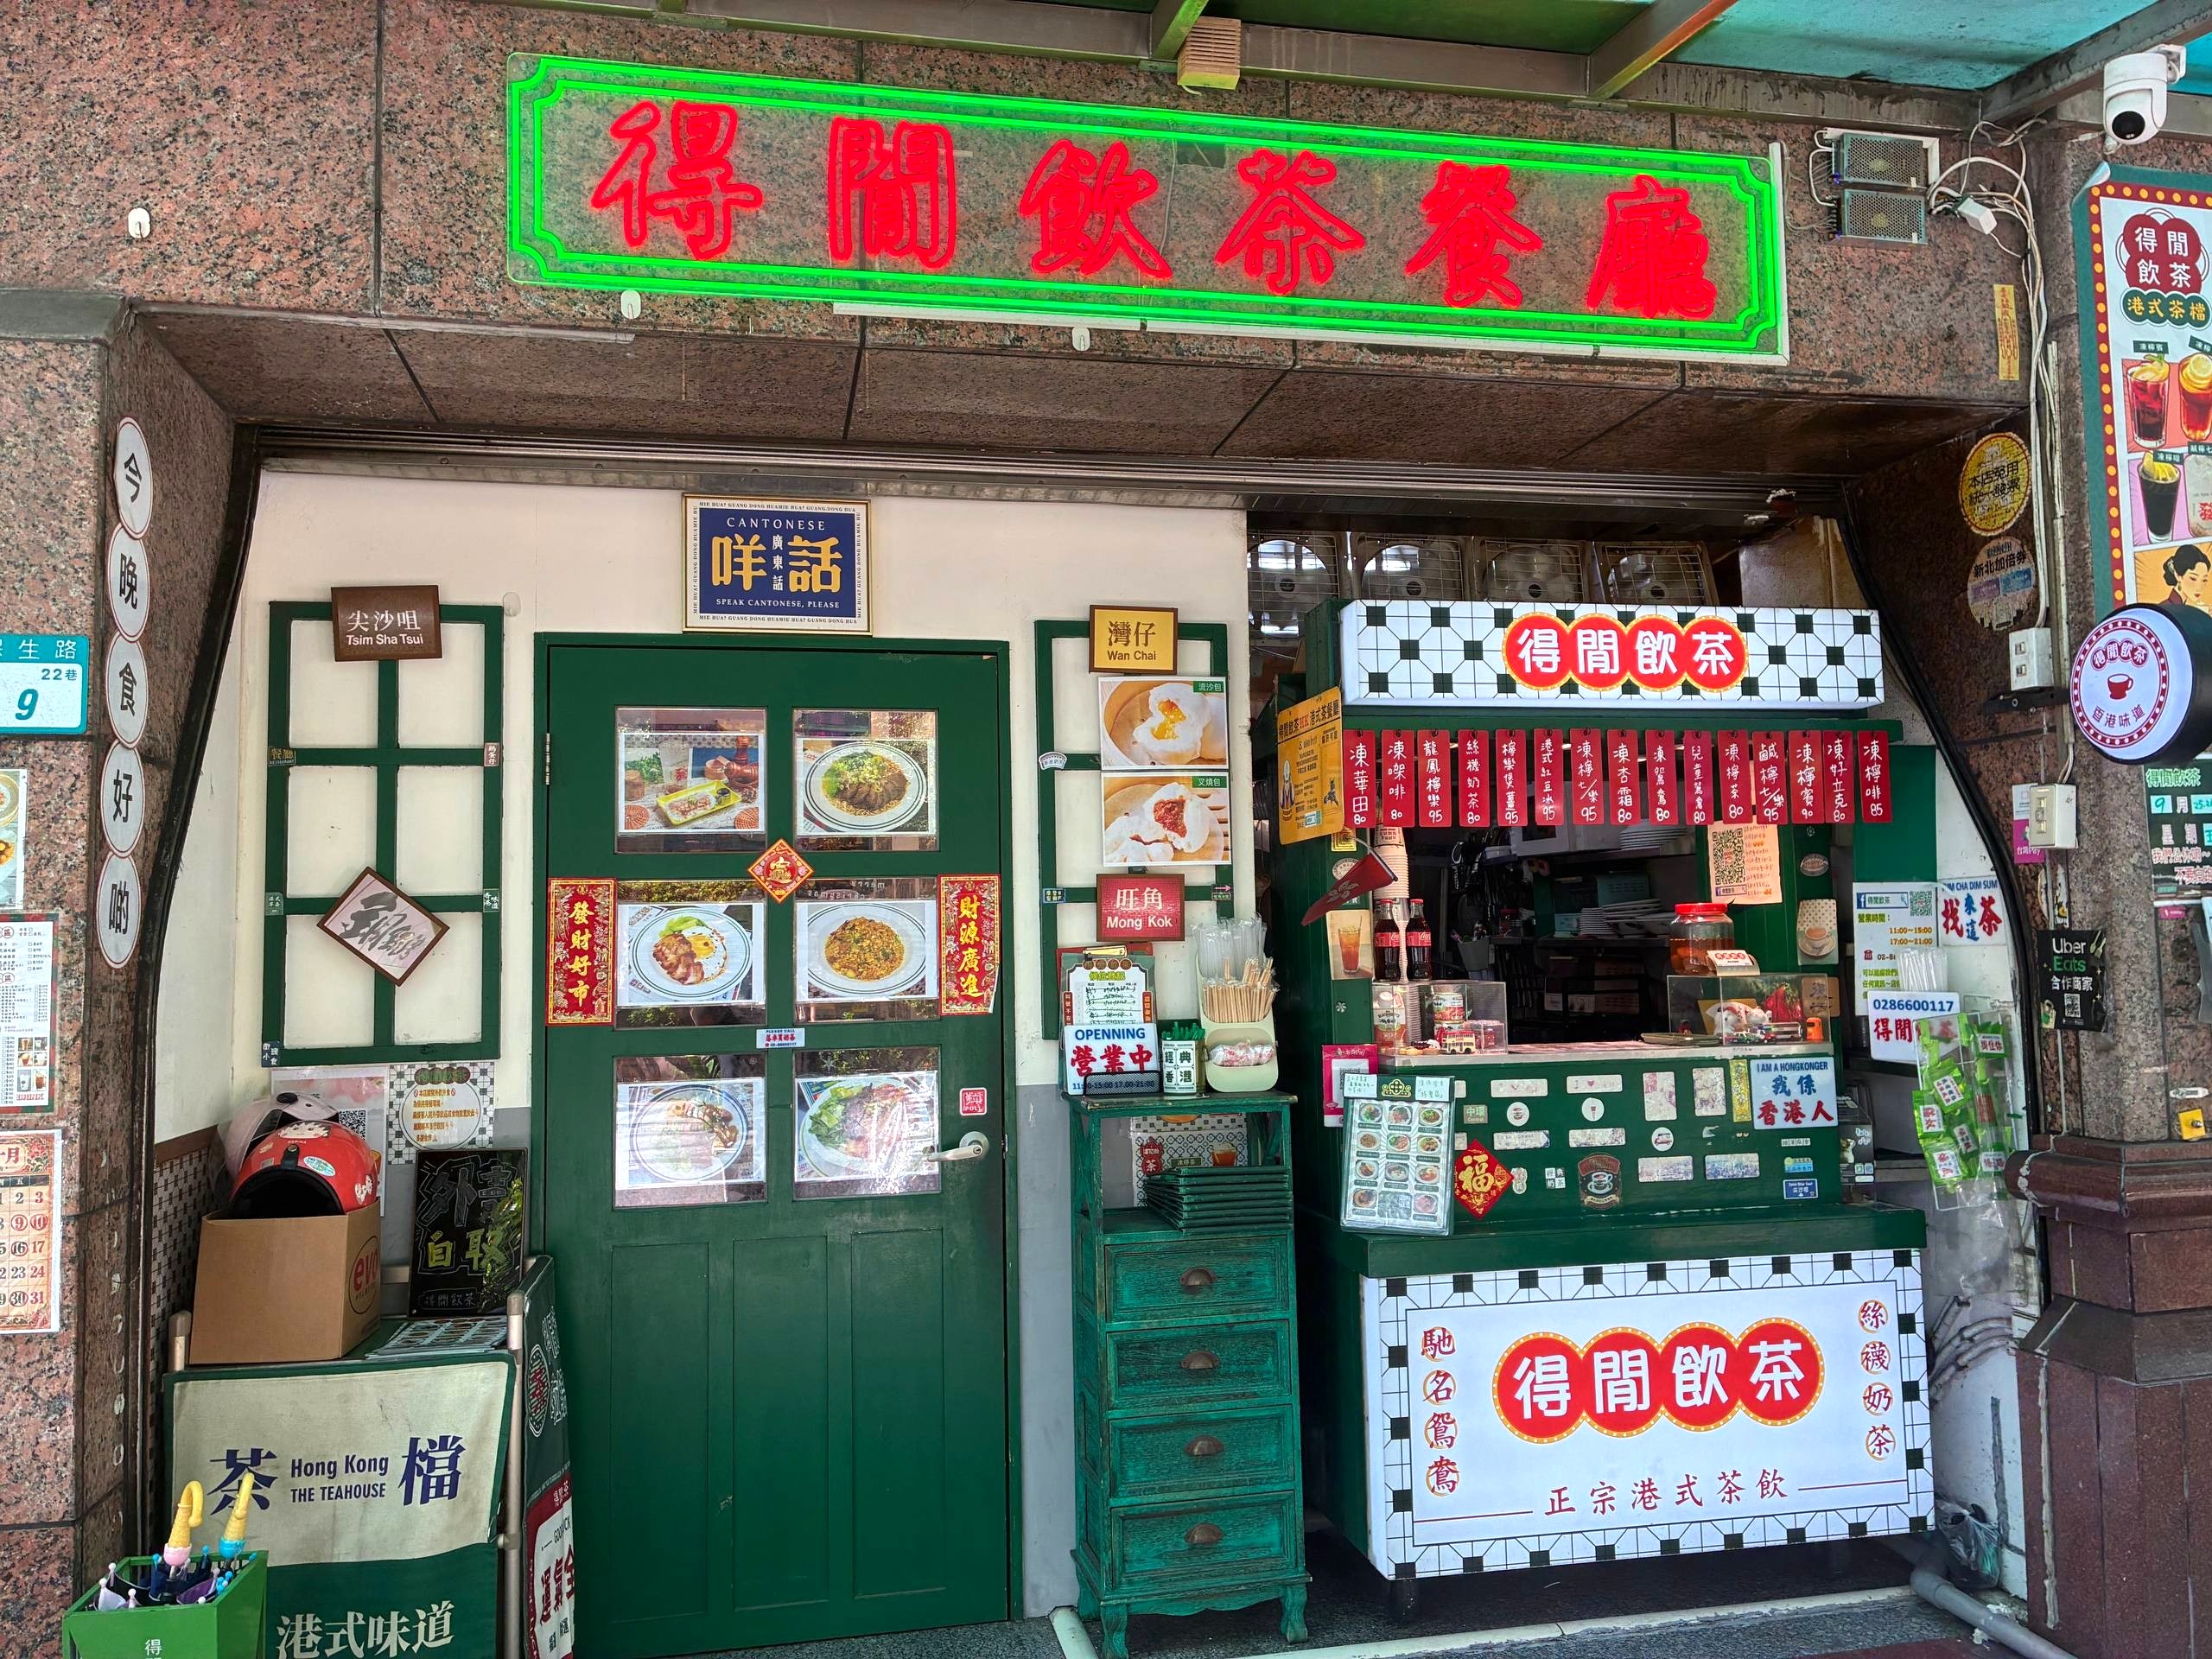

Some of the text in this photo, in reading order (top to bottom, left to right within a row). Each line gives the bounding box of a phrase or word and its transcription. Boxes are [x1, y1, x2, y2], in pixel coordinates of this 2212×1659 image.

[2134, 226, 2190, 257] 得閒
[2137, 258, 2191, 288] 飲茶
[2127, 296, 2206, 321] 港式茶檔
[1968, 461, 2019, 486] 本店免用
[1968, 478, 2021, 506] 統一發票
[727, 518, 825, 531] CANTONESE
[711, 533, 843, 593] 咩 廣東話 話
[747, 600, 804, 608] CANTONESE,
[346, 610, 422, 632] 尖沙咀
[346, 633, 423, 646] Tsim Sha Tsui
[1108, 620, 1156, 648] 灣仔
[0, 639, 77, 659] 生路
[1107, 650, 1157, 661] Wan Chai
[1517, 627, 1733, 677] 得閒飲茶
[41, 668, 78, 681] 22巷
[16, 689, 39, 720] 9
[2092, 704, 2145, 728] 香港味道
[1541, 805, 1554, 821] 95
[1728, 805, 1744, 819] 80
[1869, 803, 1884, 816] 85
[2155, 797, 2165, 813] 9
[2176, 796, 2189, 814] 月
[1353, 814, 1366, 825] 80
[1390, 810, 1402, 820] 80
[1428, 810, 1443, 823] 95
[1467, 811, 1480, 824] 80
[1504, 811, 1518, 824] 95
[1581, 806, 1597, 822] 95
[1618, 808, 1632, 822] 80
[1656, 808, 1670, 821] 80
[1694, 811, 1706, 823] 80
[1763, 808, 1779, 823] 95
[1801, 808, 1814, 819] 90
[1833, 809, 1846, 822] 80
[1943, 880, 1998, 892] UM CHA DIM SUM
[1116, 887, 1163, 910] 旺角
[1107, 914, 1173, 931] Mong Kok
[568, 900, 595, 1007] 發財好市
[957, 893, 985, 999] 財源廣進
[2052, 938, 2087, 954] Uber
[2053, 956, 2087, 972] Eats
[2050, 976, 2093, 992] 合作商家
[1872, 999, 1954, 1012] 0286600117
[1075, 1027, 1146, 1040] OPENNING
[1873, 1017, 1957, 1044] 得閒茶
[1071, 1044, 1153, 1077] 營業中
[1761, 1063, 1772, 1071] AM
[1774, 1063, 1779, 1071] A
[1781, 1061, 1828, 1071] HONGKONGER
[1771, 1074, 1817, 1096] 我係
[1757, 1099, 1834, 1126] 香港人
[1458, 1154, 1495, 1193] 福
[16, 1191, 43, 1205] 2 3
[15, 1217, 24, 1230] 9
[32, 1241, 45, 1253] 17
[11, 1266, 45, 1279] 23 24
[11, 1291, 44, 1305] 30 31
[1512, 1338, 1805, 1420] 得閒飲茶
[1859, 1300, 1895, 1457] 絲襪奶茶
[1421, 1326, 1460, 1495] 馳名鴛鴦
[290, 1453, 389, 1480] Hong Kong
[207, 1447, 278, 1516] 茶
[398, 1434, 467, 1507] 檔
[290, 1483, 386, 1503] THE TEAHOUSE
[1543, 1468, 1789, 1517] 正宗港式茶飲
[276, 1600, 455, 1659] 港式味道
[145, 1639, 162, 1659] 得
